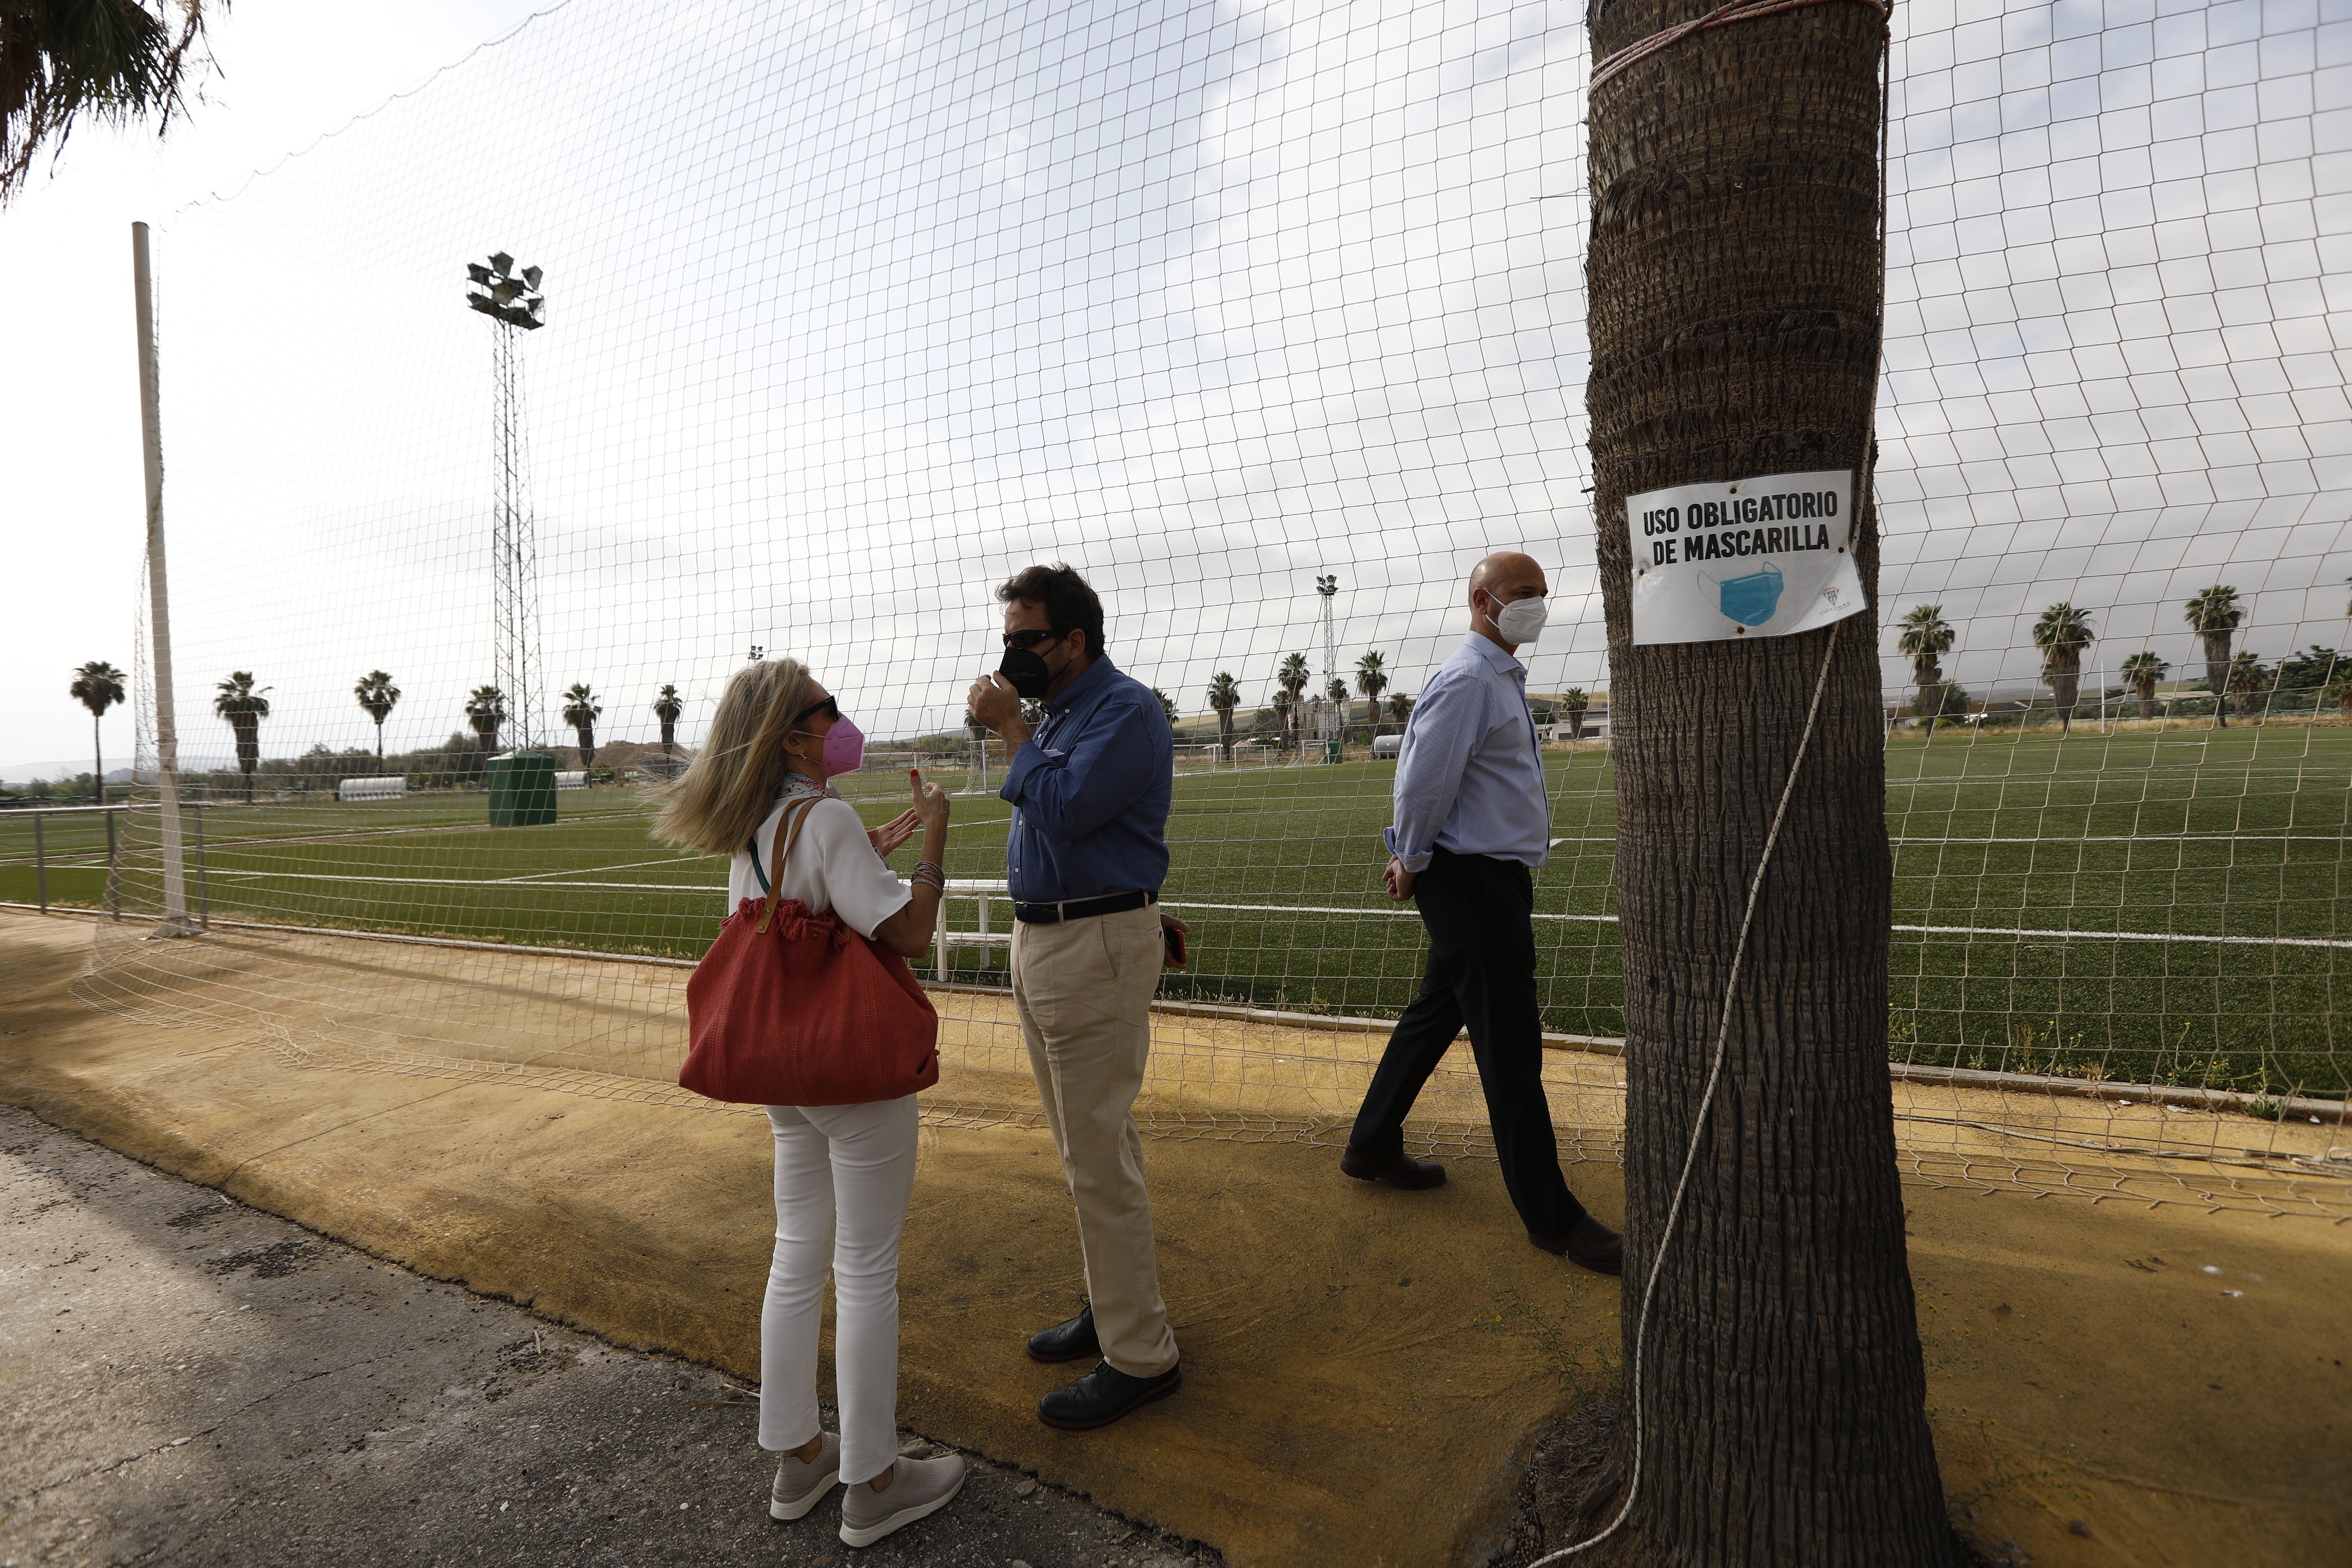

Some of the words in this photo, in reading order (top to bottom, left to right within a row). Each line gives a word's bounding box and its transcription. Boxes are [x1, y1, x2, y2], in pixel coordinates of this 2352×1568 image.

[1643, 507, 1680, 536] USO
[1687, 491, 1838, 530] OBLIGATORIO
[1653, 538, 1678, 566] DE
[1684, 524, 1830, 562] MASCARILLA
